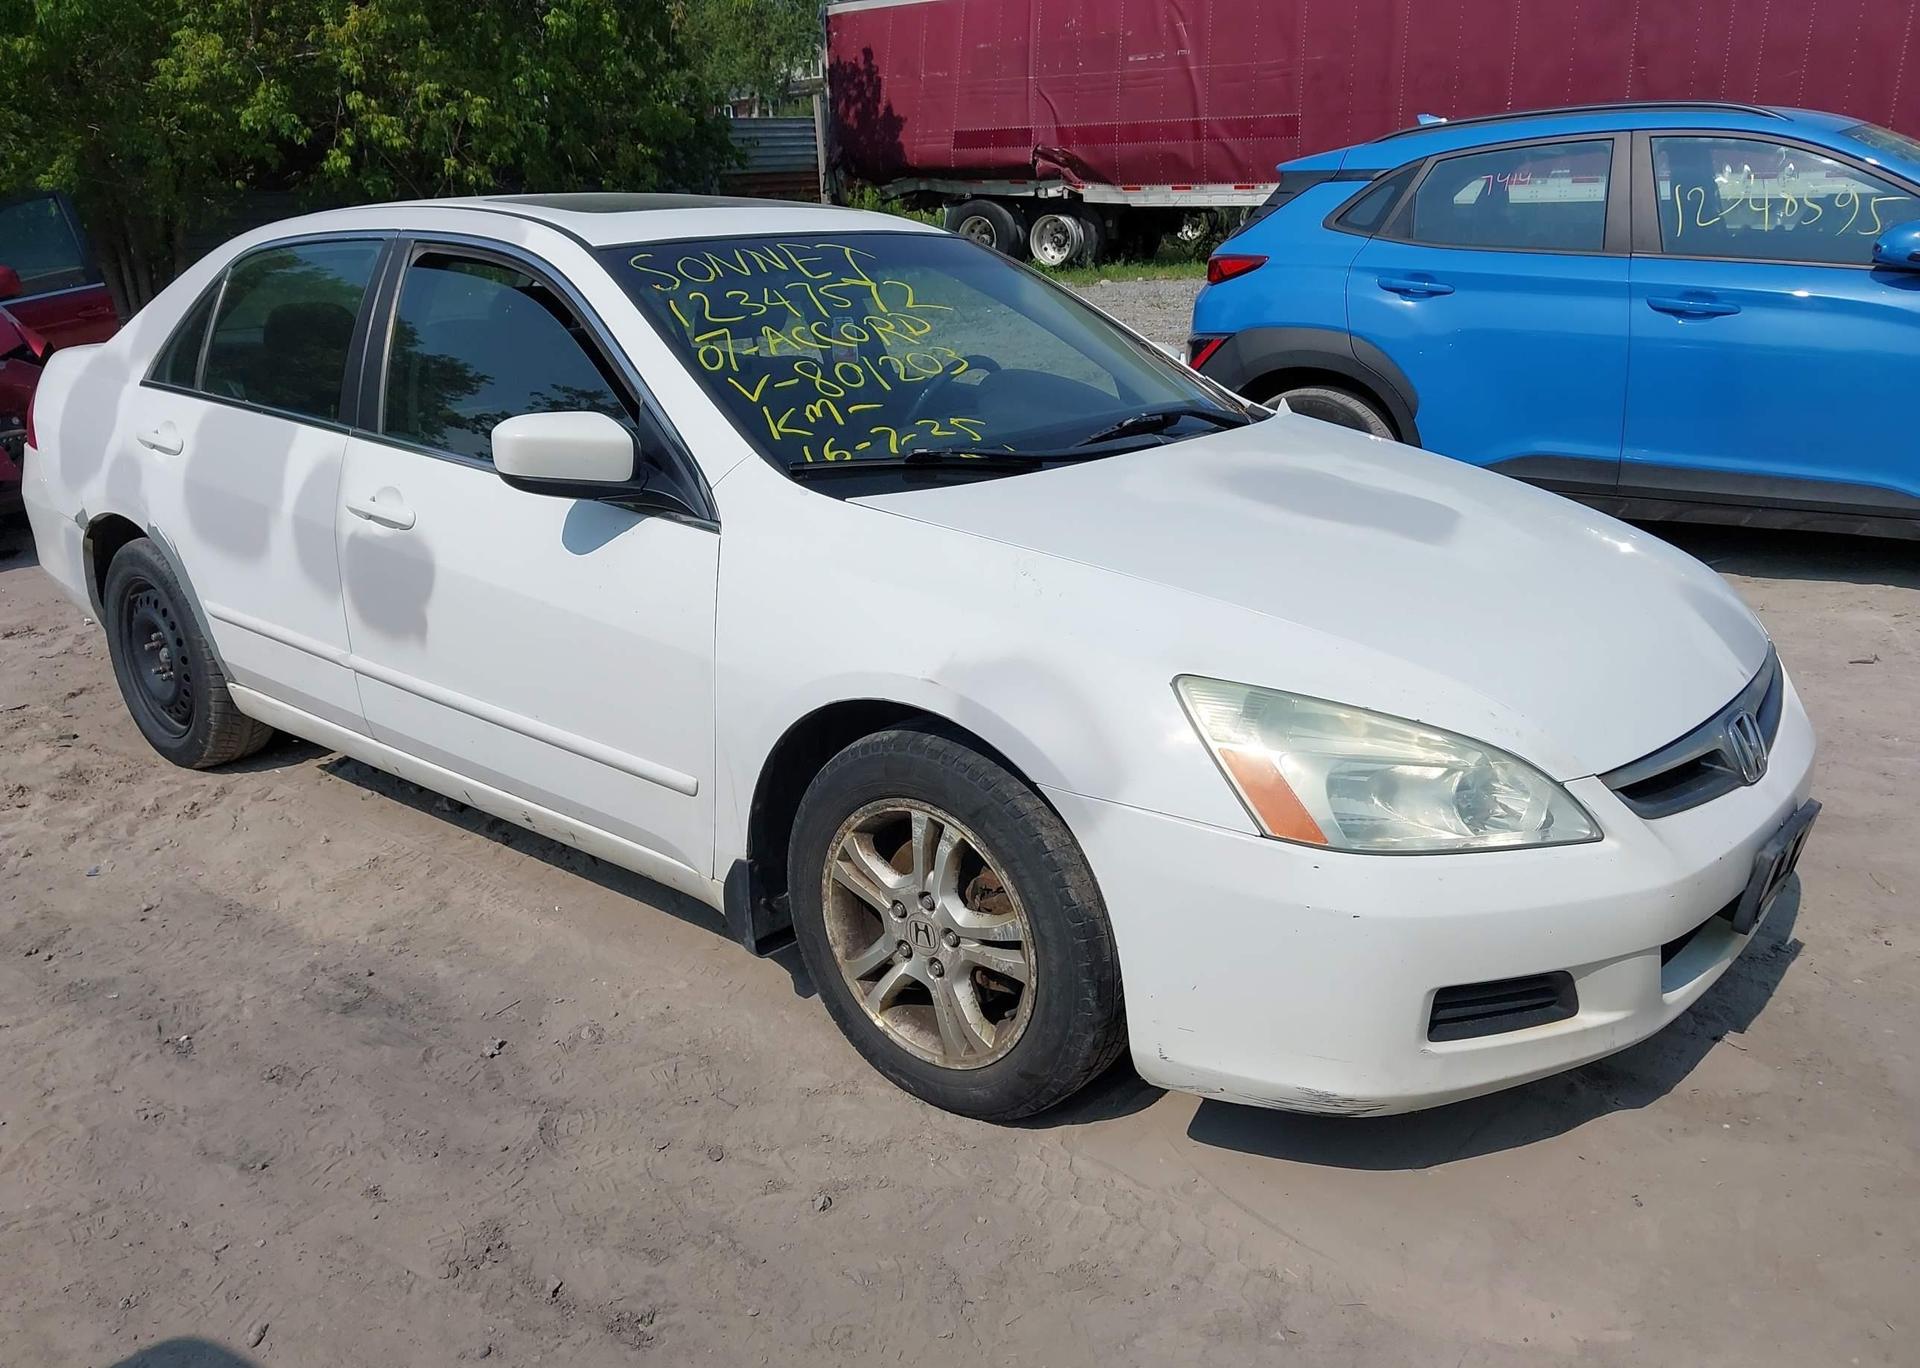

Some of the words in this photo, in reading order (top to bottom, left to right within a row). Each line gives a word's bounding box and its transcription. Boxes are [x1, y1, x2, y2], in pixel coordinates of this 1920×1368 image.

[627, 243, 877, 291] SONNET
[694, 312, 932, 372] 07-ACCORD
[727, 346, 970, 402] V-801203
